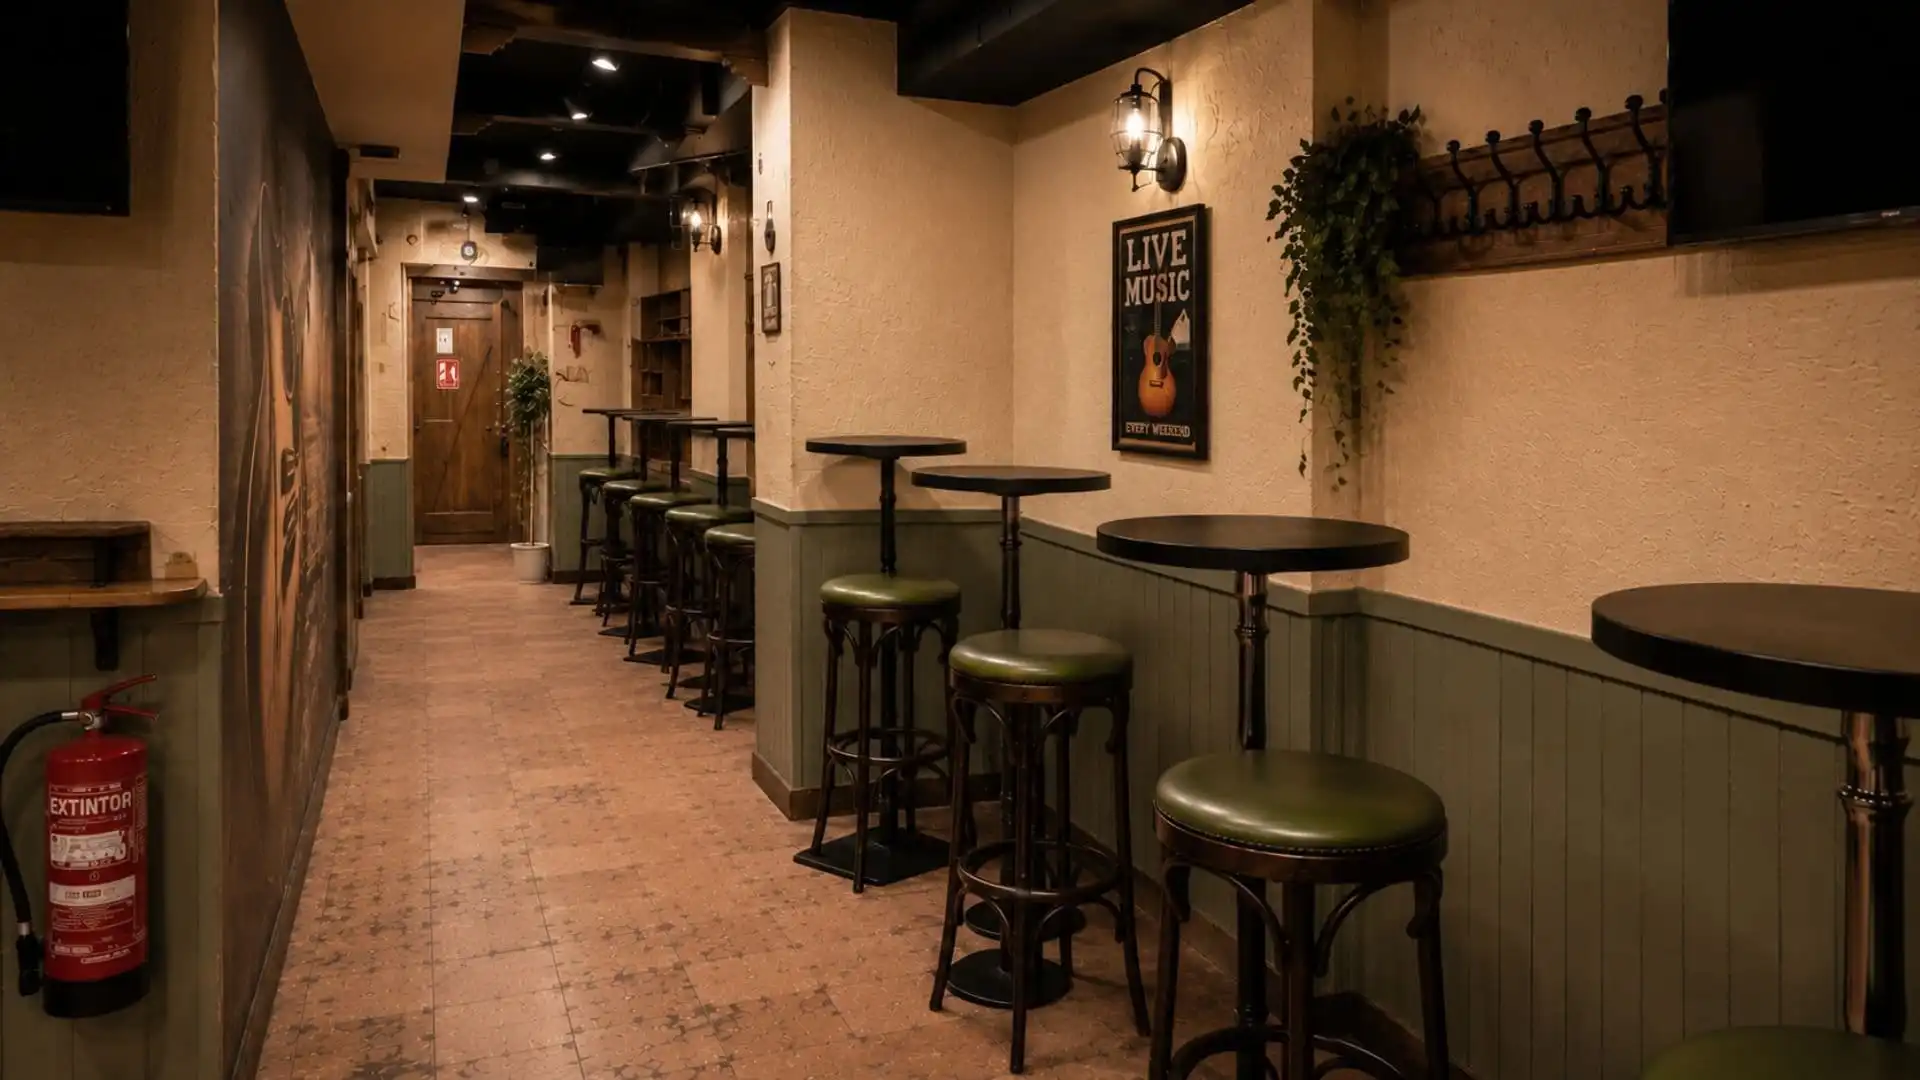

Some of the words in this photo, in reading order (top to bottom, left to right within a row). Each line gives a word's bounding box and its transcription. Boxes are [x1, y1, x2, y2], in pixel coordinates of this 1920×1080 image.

[1126, 229, 1187, 273] LIVE
[1124, 268, 1191, 307] MUSIC
[1125, 421, 1150, 435] EVERY
[1152, 423, 1191, 438] WEEKEND
[50, 791, 132, 816] EXTINTOR
